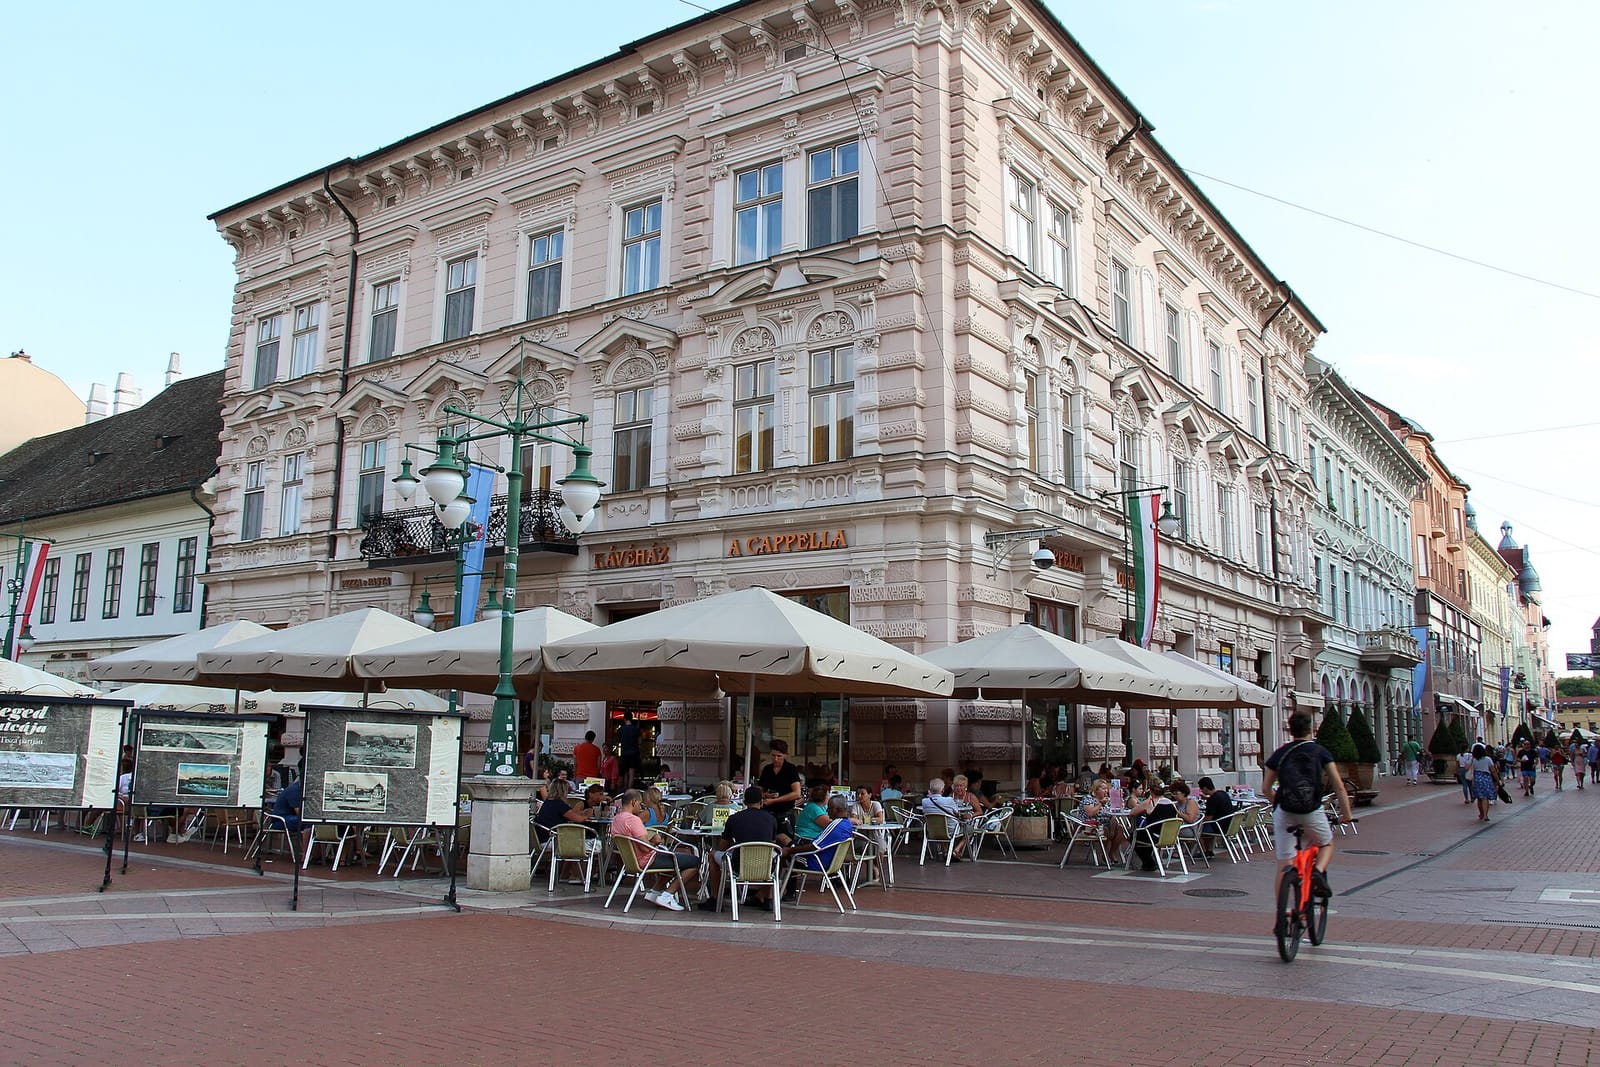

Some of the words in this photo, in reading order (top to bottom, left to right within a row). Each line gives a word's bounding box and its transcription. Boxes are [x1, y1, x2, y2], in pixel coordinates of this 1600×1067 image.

[593, 542, 671, 569] KÁVÉHÁZ
[728, 538, 742, 557] A
[746, 529, 848, 555] CAPPELLA
[0, 705, 49, 721] eged
